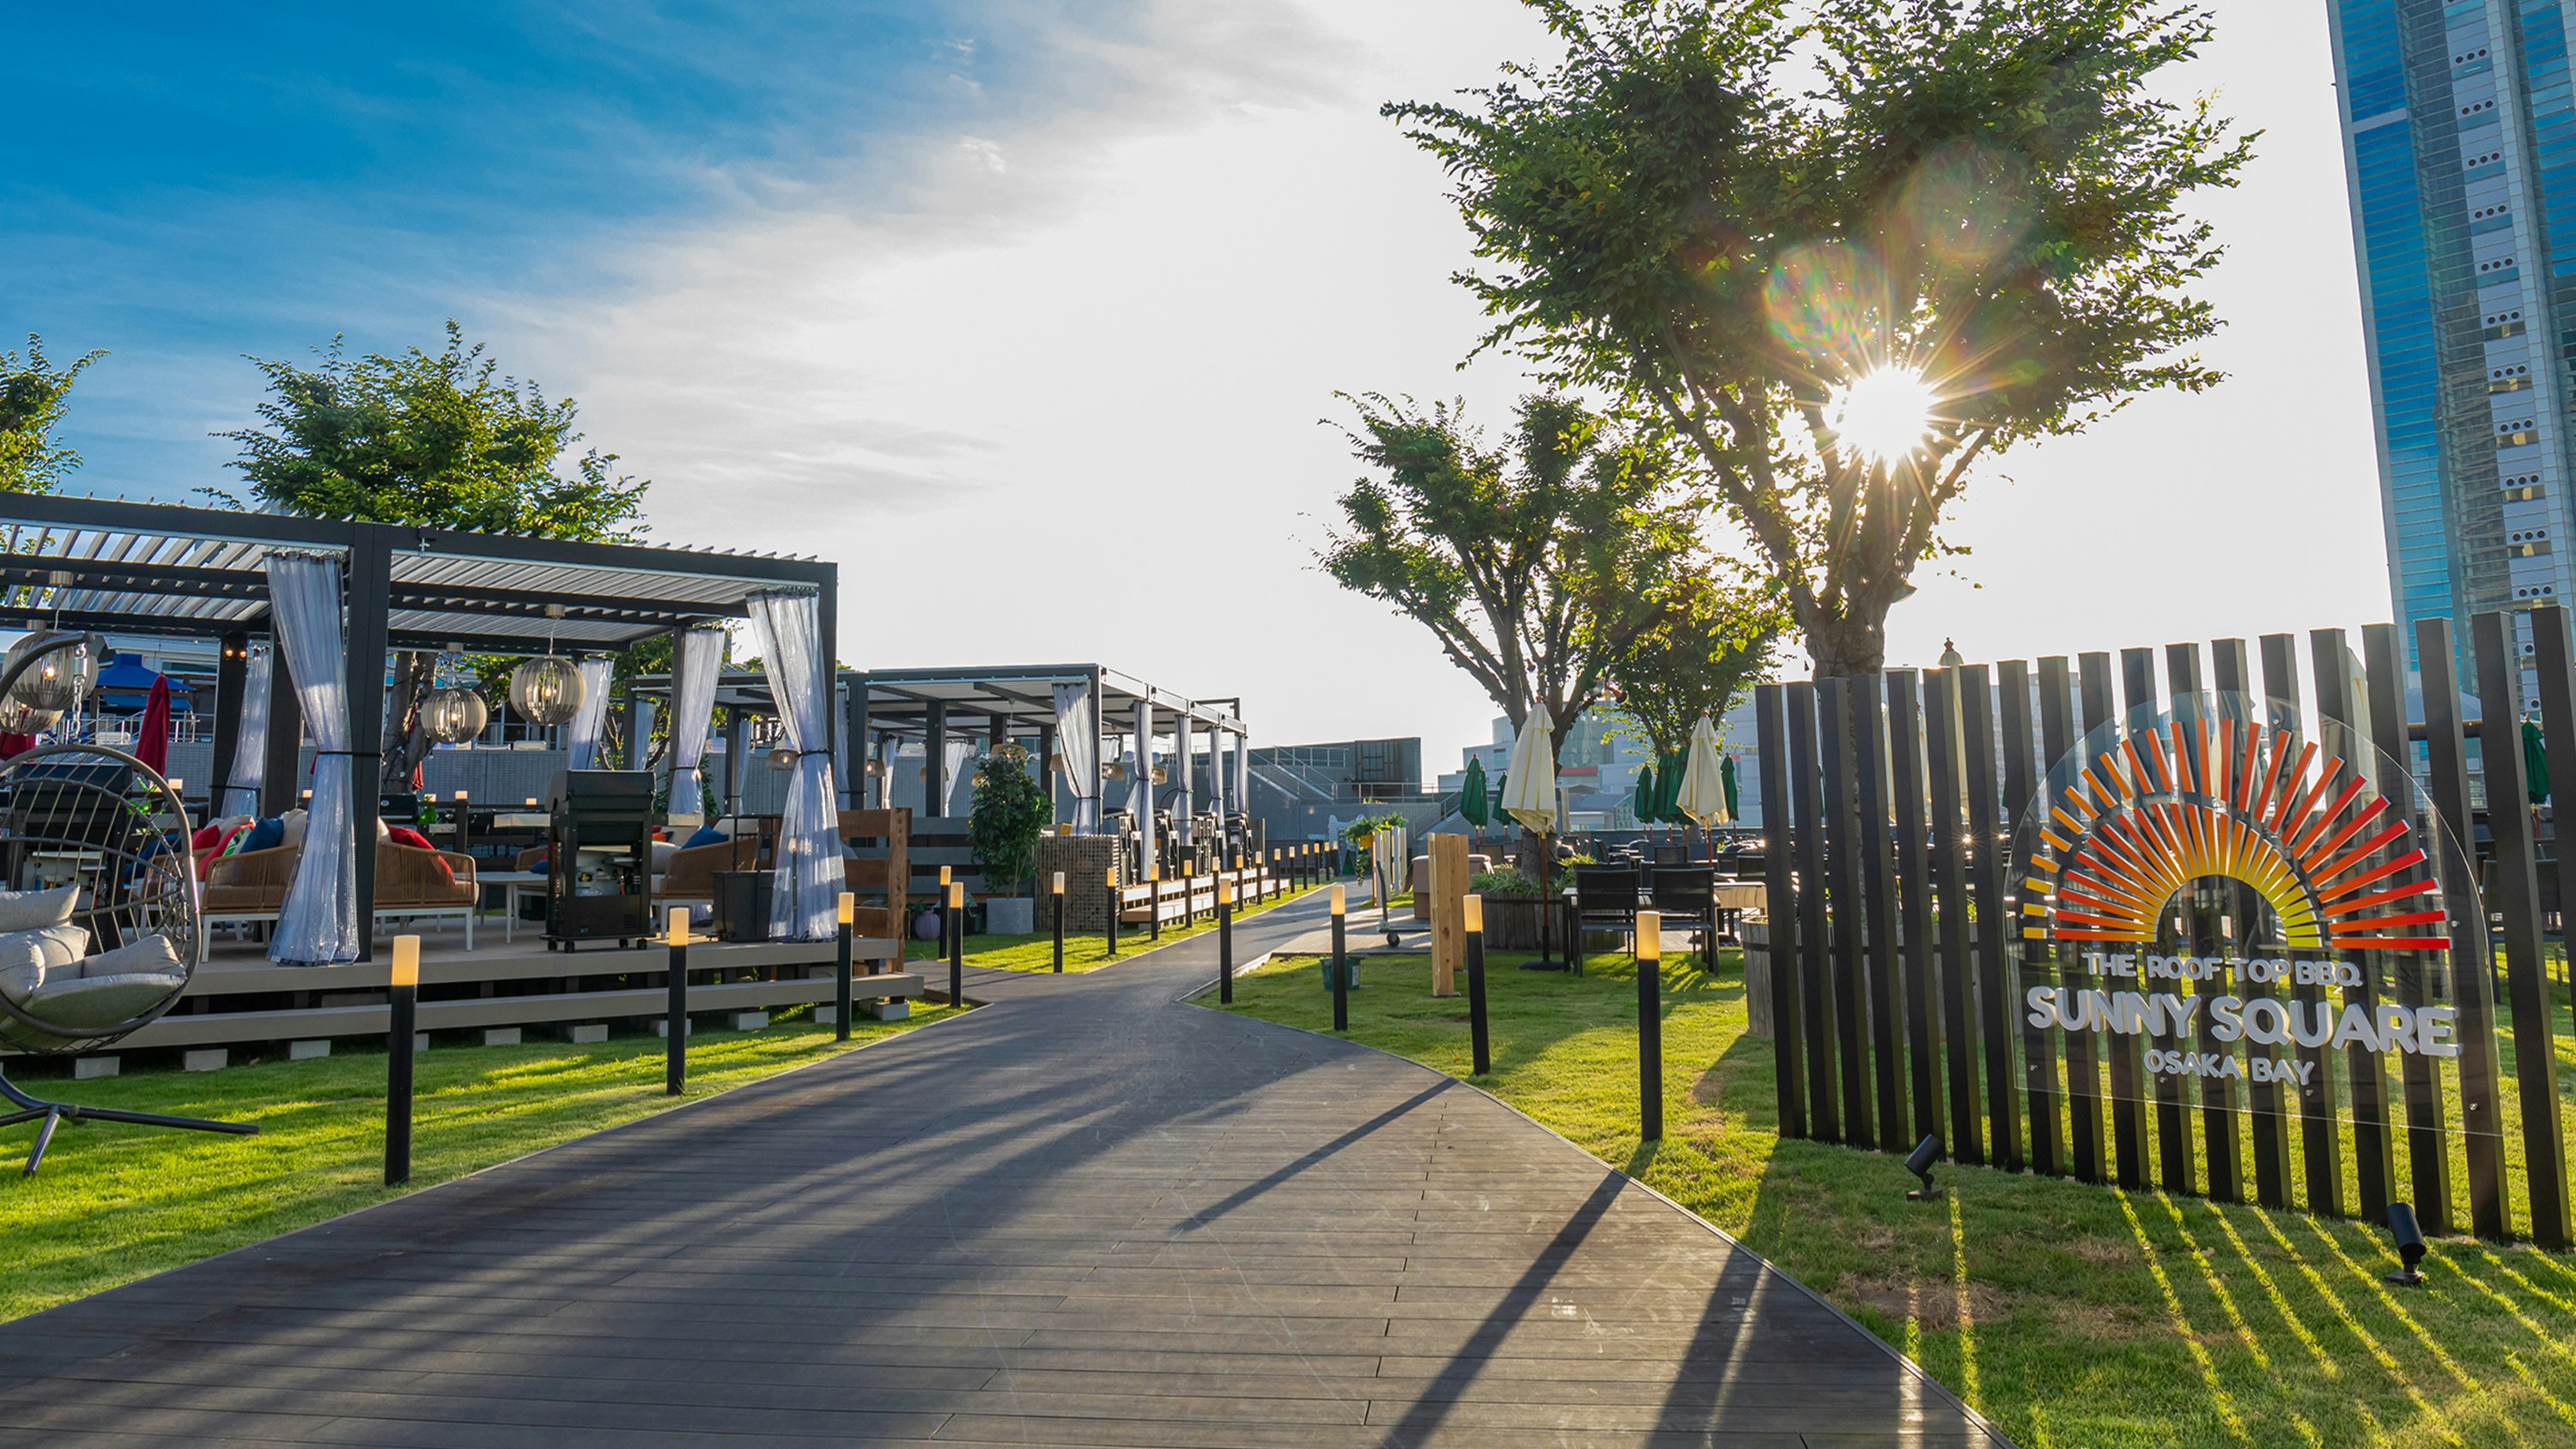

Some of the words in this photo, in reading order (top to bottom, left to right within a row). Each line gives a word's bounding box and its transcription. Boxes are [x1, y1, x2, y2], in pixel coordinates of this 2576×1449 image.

[2082, 952, 2137, 978] THE
[2148, 955, 2224, 980] ROOF
[2230, 958, 2290, 984] TOP
[2295, 960, 2363, 988] BBQ
[2026, 985, 2202, 1038] SUNNY
[2209, 996, 2462, 1056] SQUARE
[2145, 1048, 2242, 1080] OSAKA
[2251, 1057, 2315, 1085] BAY
